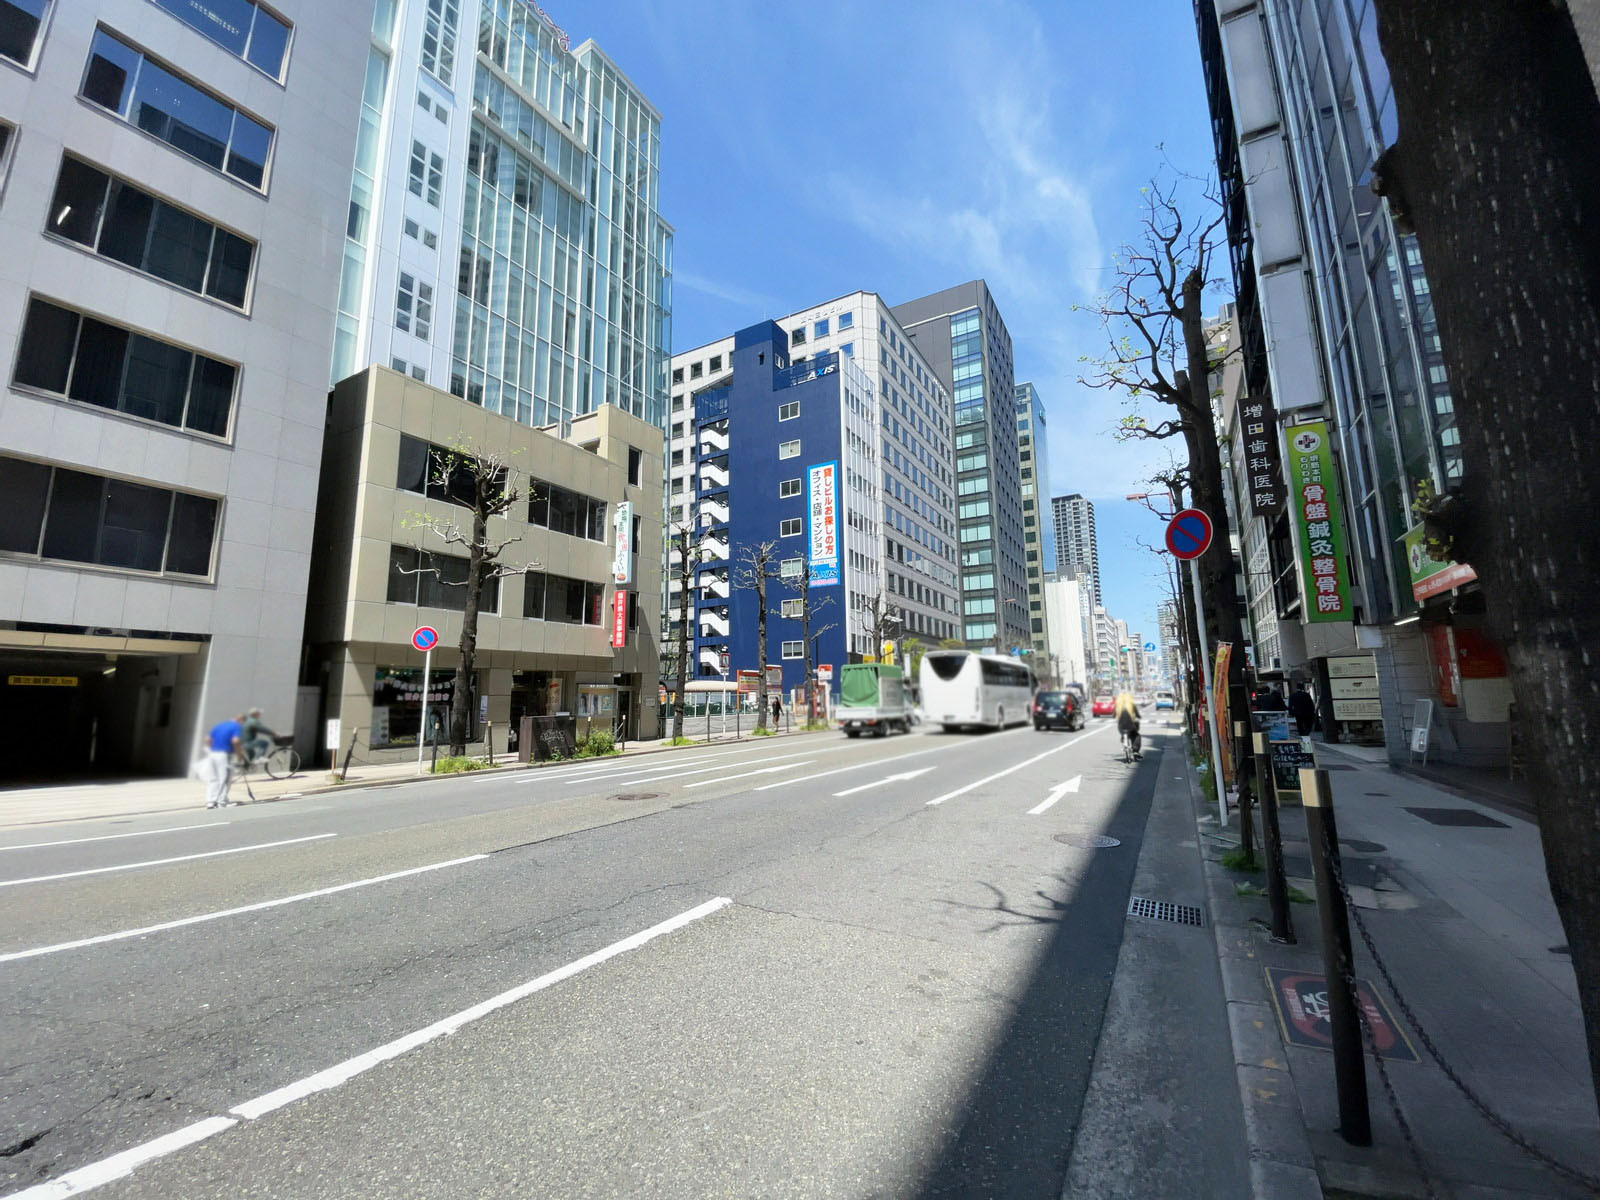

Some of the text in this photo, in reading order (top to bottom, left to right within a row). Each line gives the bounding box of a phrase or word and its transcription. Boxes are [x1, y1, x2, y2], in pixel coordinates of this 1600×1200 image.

[807, 364, 836, 380] AXIS
[1243, 403, 1276, 507] 増田歯科医院
[812, 469, 823, 556] オフィス・店舗・マンション
[823, 467, 834, 555] 貸しビルお探しの方
[1303, 484, 1341, 612] 骨盤鍼灸整骨院
